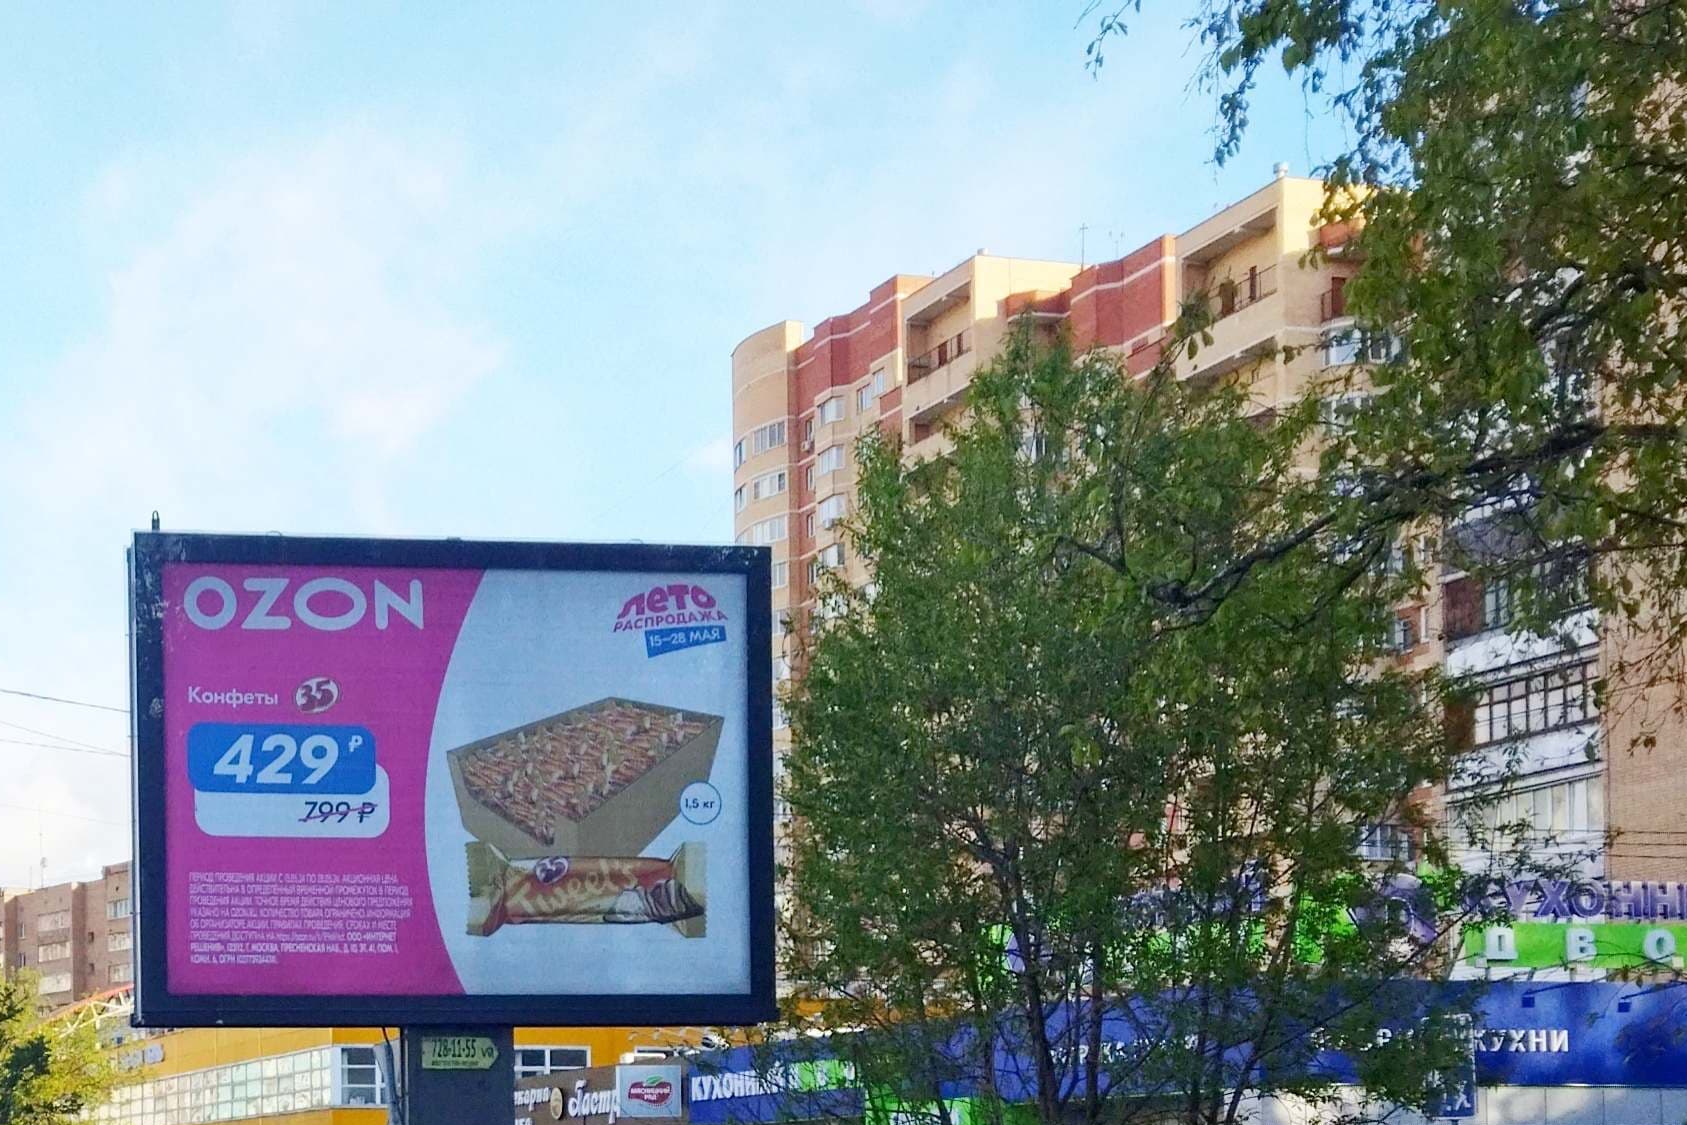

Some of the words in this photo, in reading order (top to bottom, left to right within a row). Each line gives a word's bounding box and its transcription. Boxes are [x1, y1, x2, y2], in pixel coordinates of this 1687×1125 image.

[183, 576, 424, 631] OZON
[613, 610, 728, 633] РАСПРОДАЖА
[690, 628, 720, 643] МАЯ
[187, 686, 279, 708] Конфеты
[213, 733, 339, 785] 429
[305, 801, 349, 823] 799
[685, 798, 699, 809] 1,5
[703, 800, 715, 809] кг
